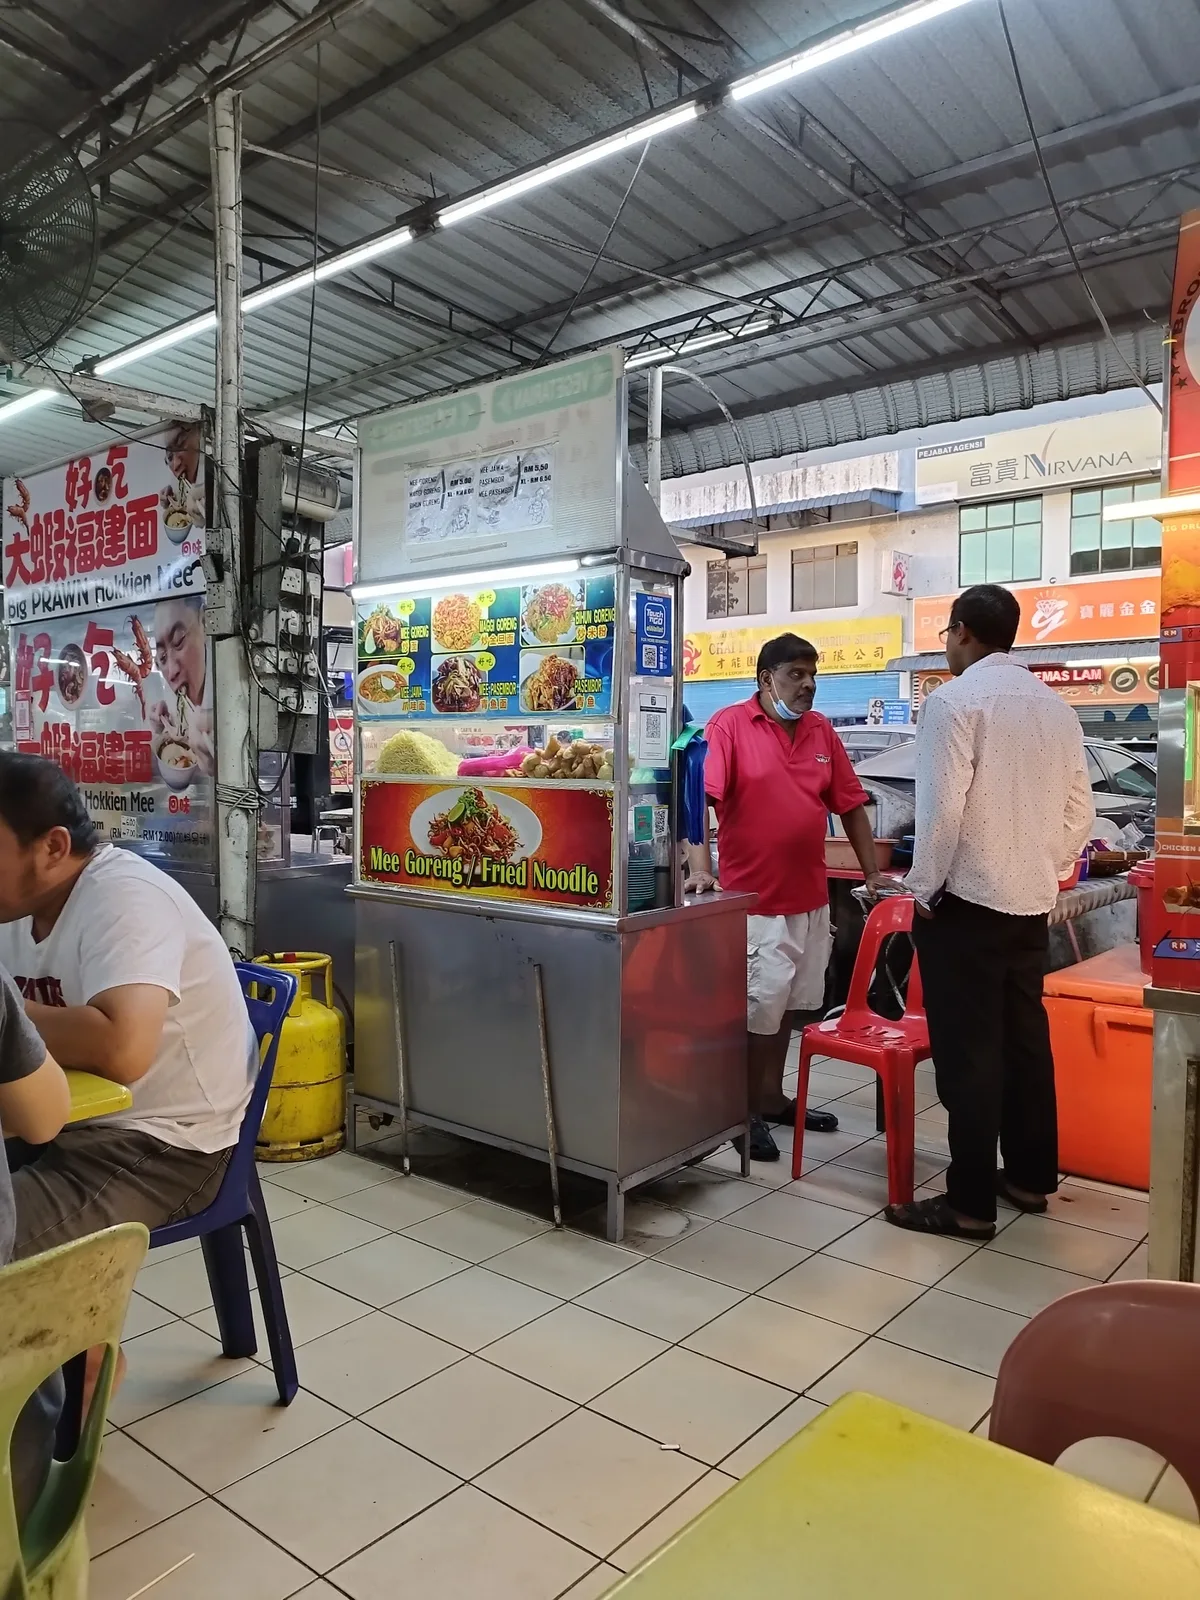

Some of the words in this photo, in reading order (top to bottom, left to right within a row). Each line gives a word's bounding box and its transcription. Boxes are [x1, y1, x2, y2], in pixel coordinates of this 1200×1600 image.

[918, 446, 952, 458] PEJABAT
[953, 440, 983, 453] AGENSI
[969, 457, 1019, 487] 富貴
[1024, 448, 1133, 480] NIRVANA
[32, 577, 89, 615] PRAWN
[95, 570, 151, 603] Hokkien
[158, 562, 193, 591] Mee
[479, 619, 495, 632] MAGGI
[496, 618, 517, 631] GORENG
[575, 610, 592, 625] BIHUN
[594, 608, 615, 623] GORENG
[401, 627, 410, 640] MEE
[410, 625, 429, 638] GORENG
[576, 624, 607, 641] 炒米粉
[401, 640, 418, 653] 炒面
[1073, 668, 1101, 681] LAM
[479, 683, 488, 696] MEE
[489, 682, 517, 696] PASEMBOR
[574, 679, 603, 694] PASEMBOR
[18, 721, 152, 784] 蝦福建面
[84, 790, 127, 812] Hokkien
[130, 791, 155, 813] Mee
[168, 795, 190, 814] 回味
[1162, 844, 1196, 852] CHICKEN
[371, 847, 401, 874] Mee
[405, 851, 463, 885] Goreng
[482, 856, 527, 887] Fried
[533, 861, 599, 895] Noodle
[1171, 941, 1187, 950] RM
